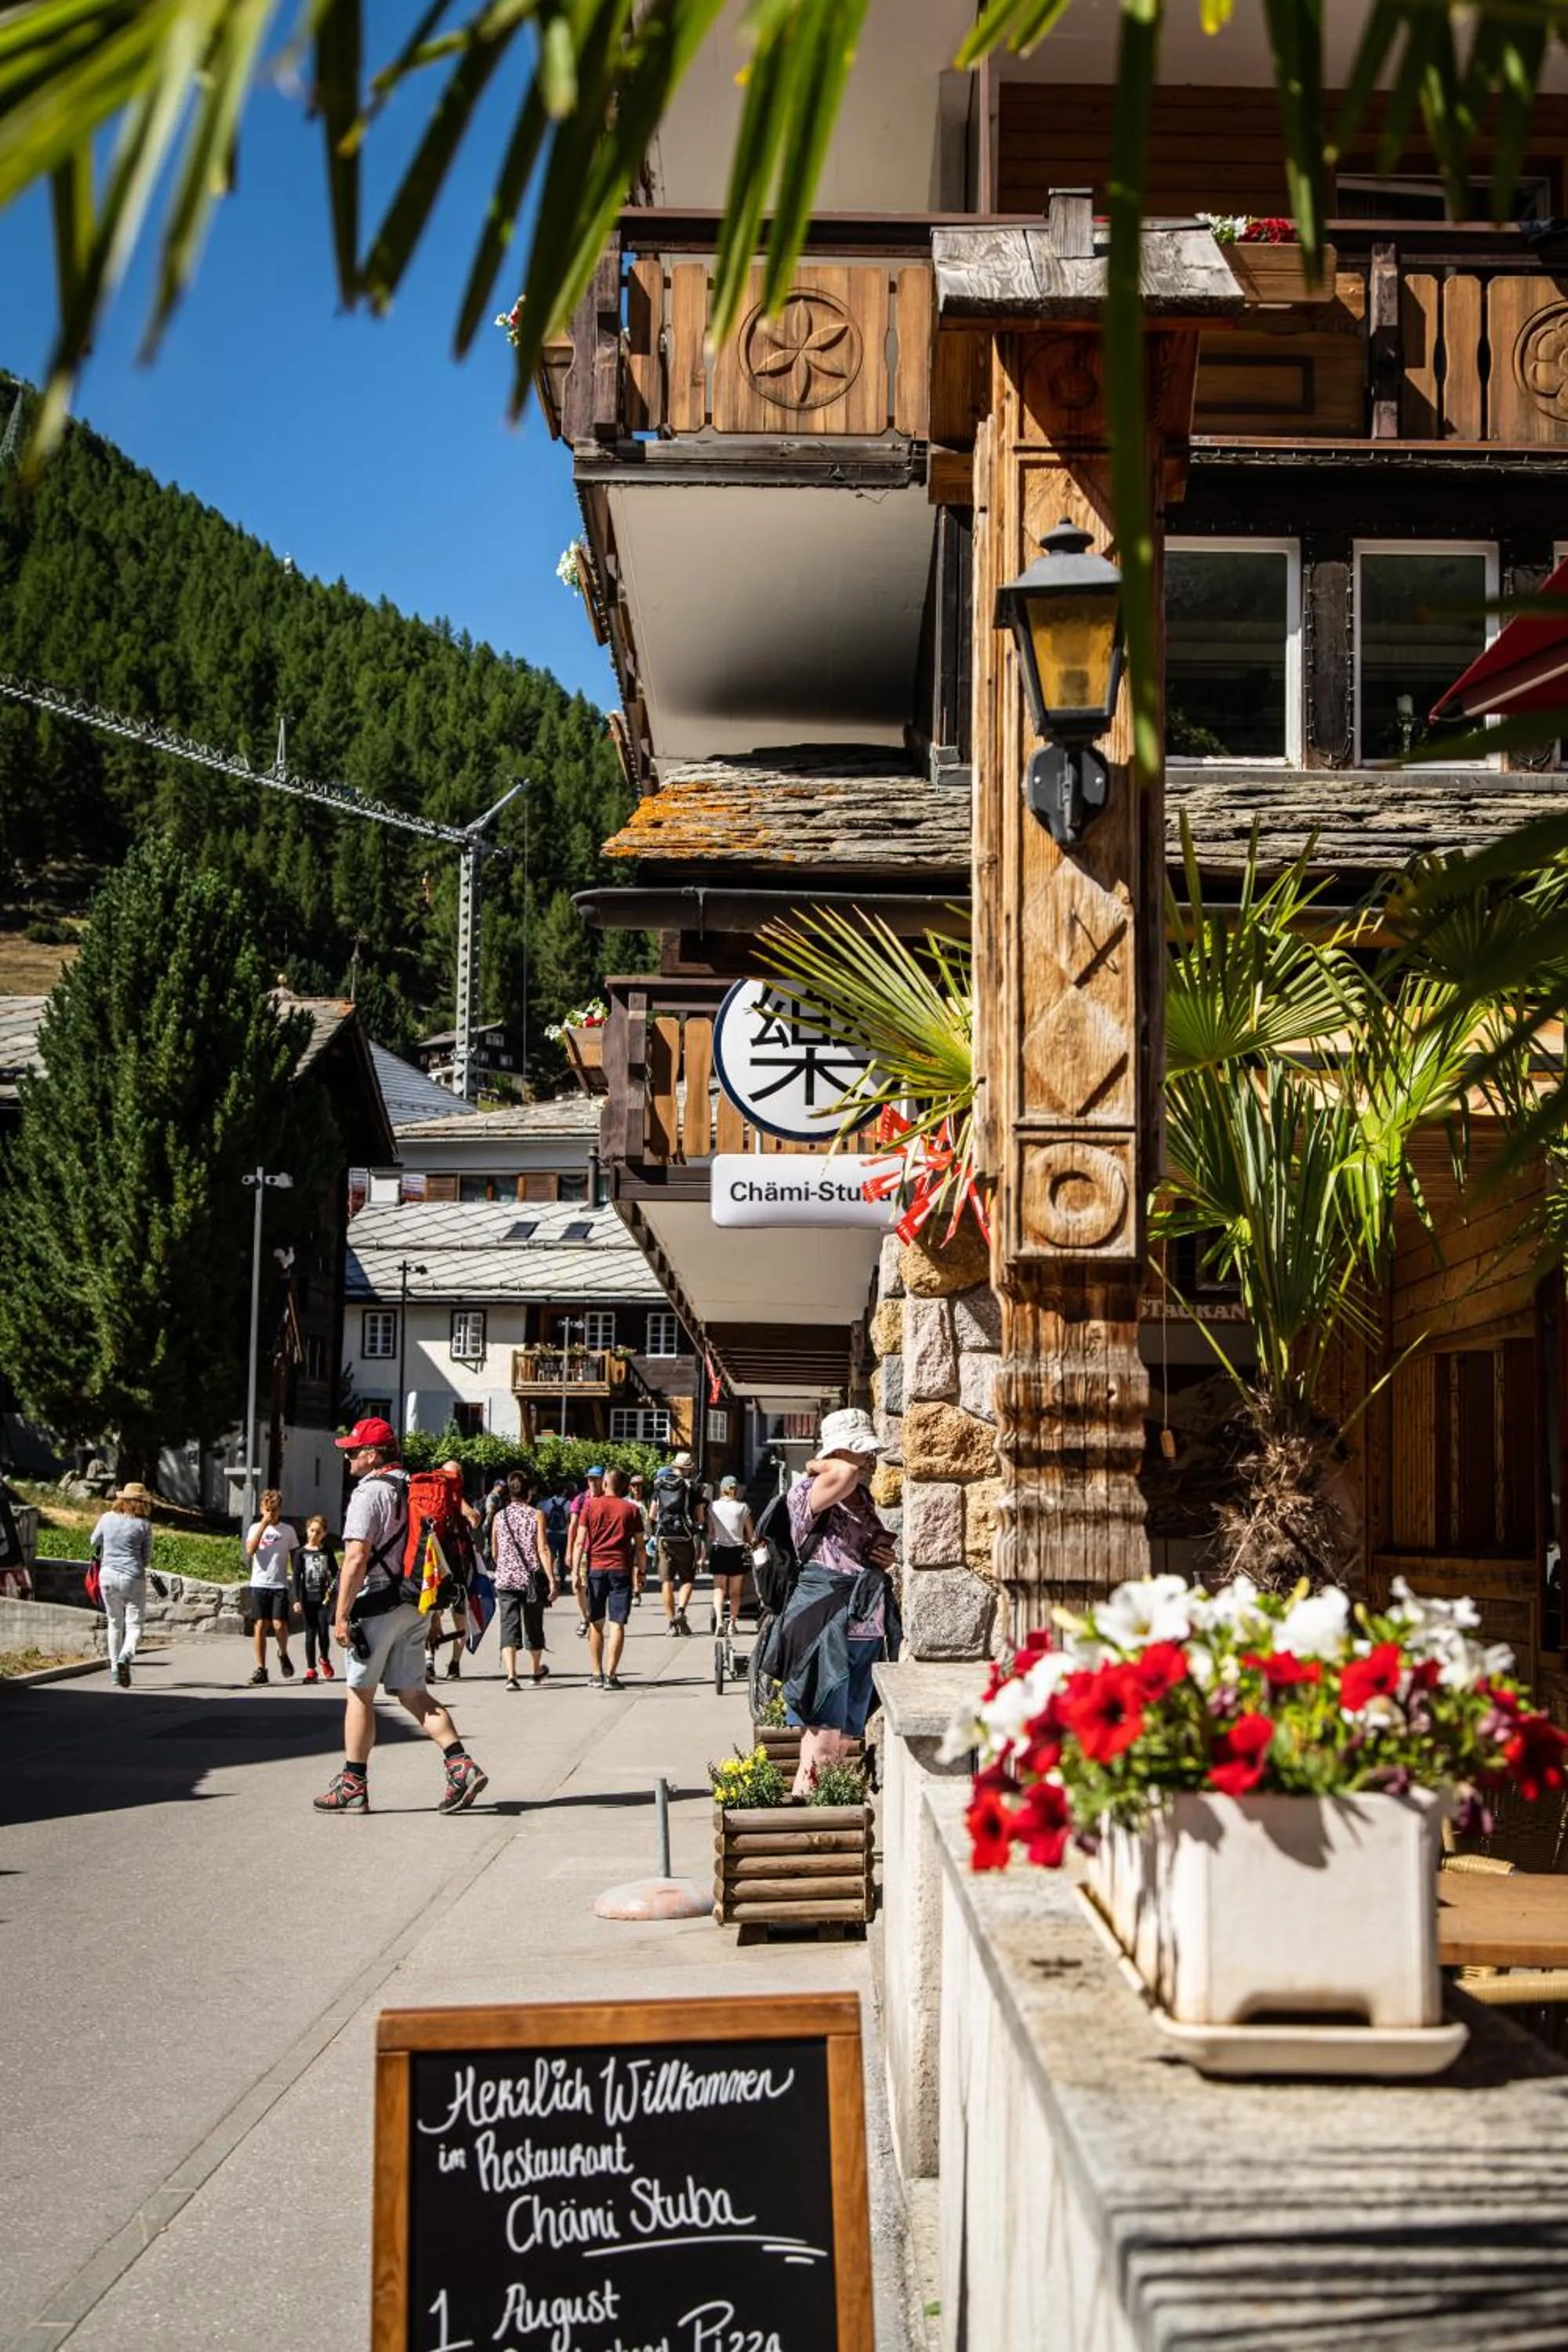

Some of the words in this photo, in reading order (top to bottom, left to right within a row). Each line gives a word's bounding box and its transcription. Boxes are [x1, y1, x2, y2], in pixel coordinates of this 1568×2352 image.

[730, 1181, 891, 1202] Chämi-Stu
[416, 2056, 593, 2134] Herzlich
[599, 2056, 795, 2127] Willkommen
[438, 2143, 467, 2173] im
[474, 2129, 633, 2193] Restaurant
[506, 2194, 622, 2252] Chämi
[630, 2175, 757, 2234] Stuba
[492, 2279, 621, 2352] August
